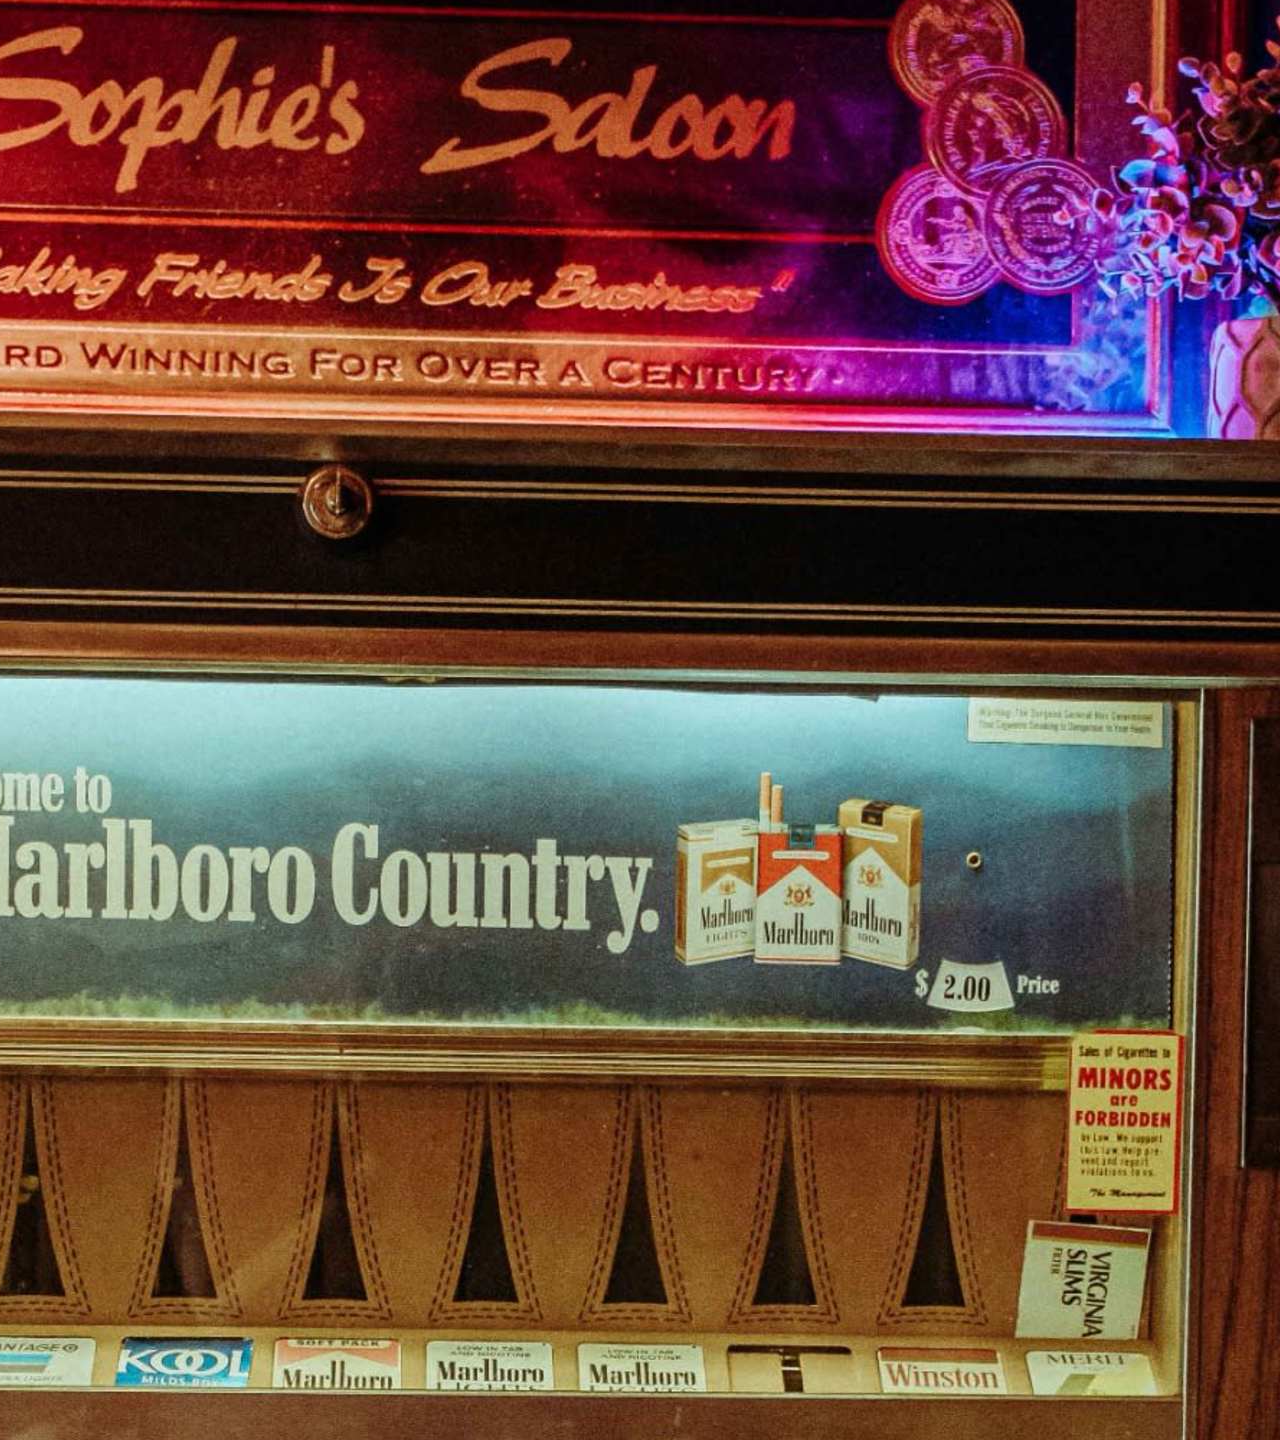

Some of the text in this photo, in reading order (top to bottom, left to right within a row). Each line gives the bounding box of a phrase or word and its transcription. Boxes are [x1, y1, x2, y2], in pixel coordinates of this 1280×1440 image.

[419, 36, 798, 175] Saloon
[137, 252, 332, 303] Friends
[420, 261, 532, 309] Our
[79, 342, 296, 380] WINNING
[310, 349, 404, 382] FOR
[418, 355, 562, 389] OVER
[559, 359, 595, 389] A
[601, 358, 824, 393] CENTURY
[73, 764, 114, 814] to
[331, 821, 661, 956] Country.
[701, 898, 754, 930] Marlboro
[763, 912, 835, 946] Marlboro
[914, 968, 1061, 1002] $ 2.00 Price
[1078, 1046, 1171, 1060] Sales of Cigarettes to
[1077, 1067, 1173, 1091] MINORS
[1109, 1094, 1139, 1107] are
[1075, 1110, 1171, 1128] FORBIDDEN
[1061, 1248, 1089, 1306] SLIMS
[1081, 1251, 1113, 1338] VIRGINIA
[118, 1348, 250, 1377] KOOL
[282, 1360, 394, 1389] Marlboro
[437, 1358, 545, 1382] Marlboro
[589, 1362, 697, 1385] Marlboro
[884, 1361, 999, 1389] Winston
